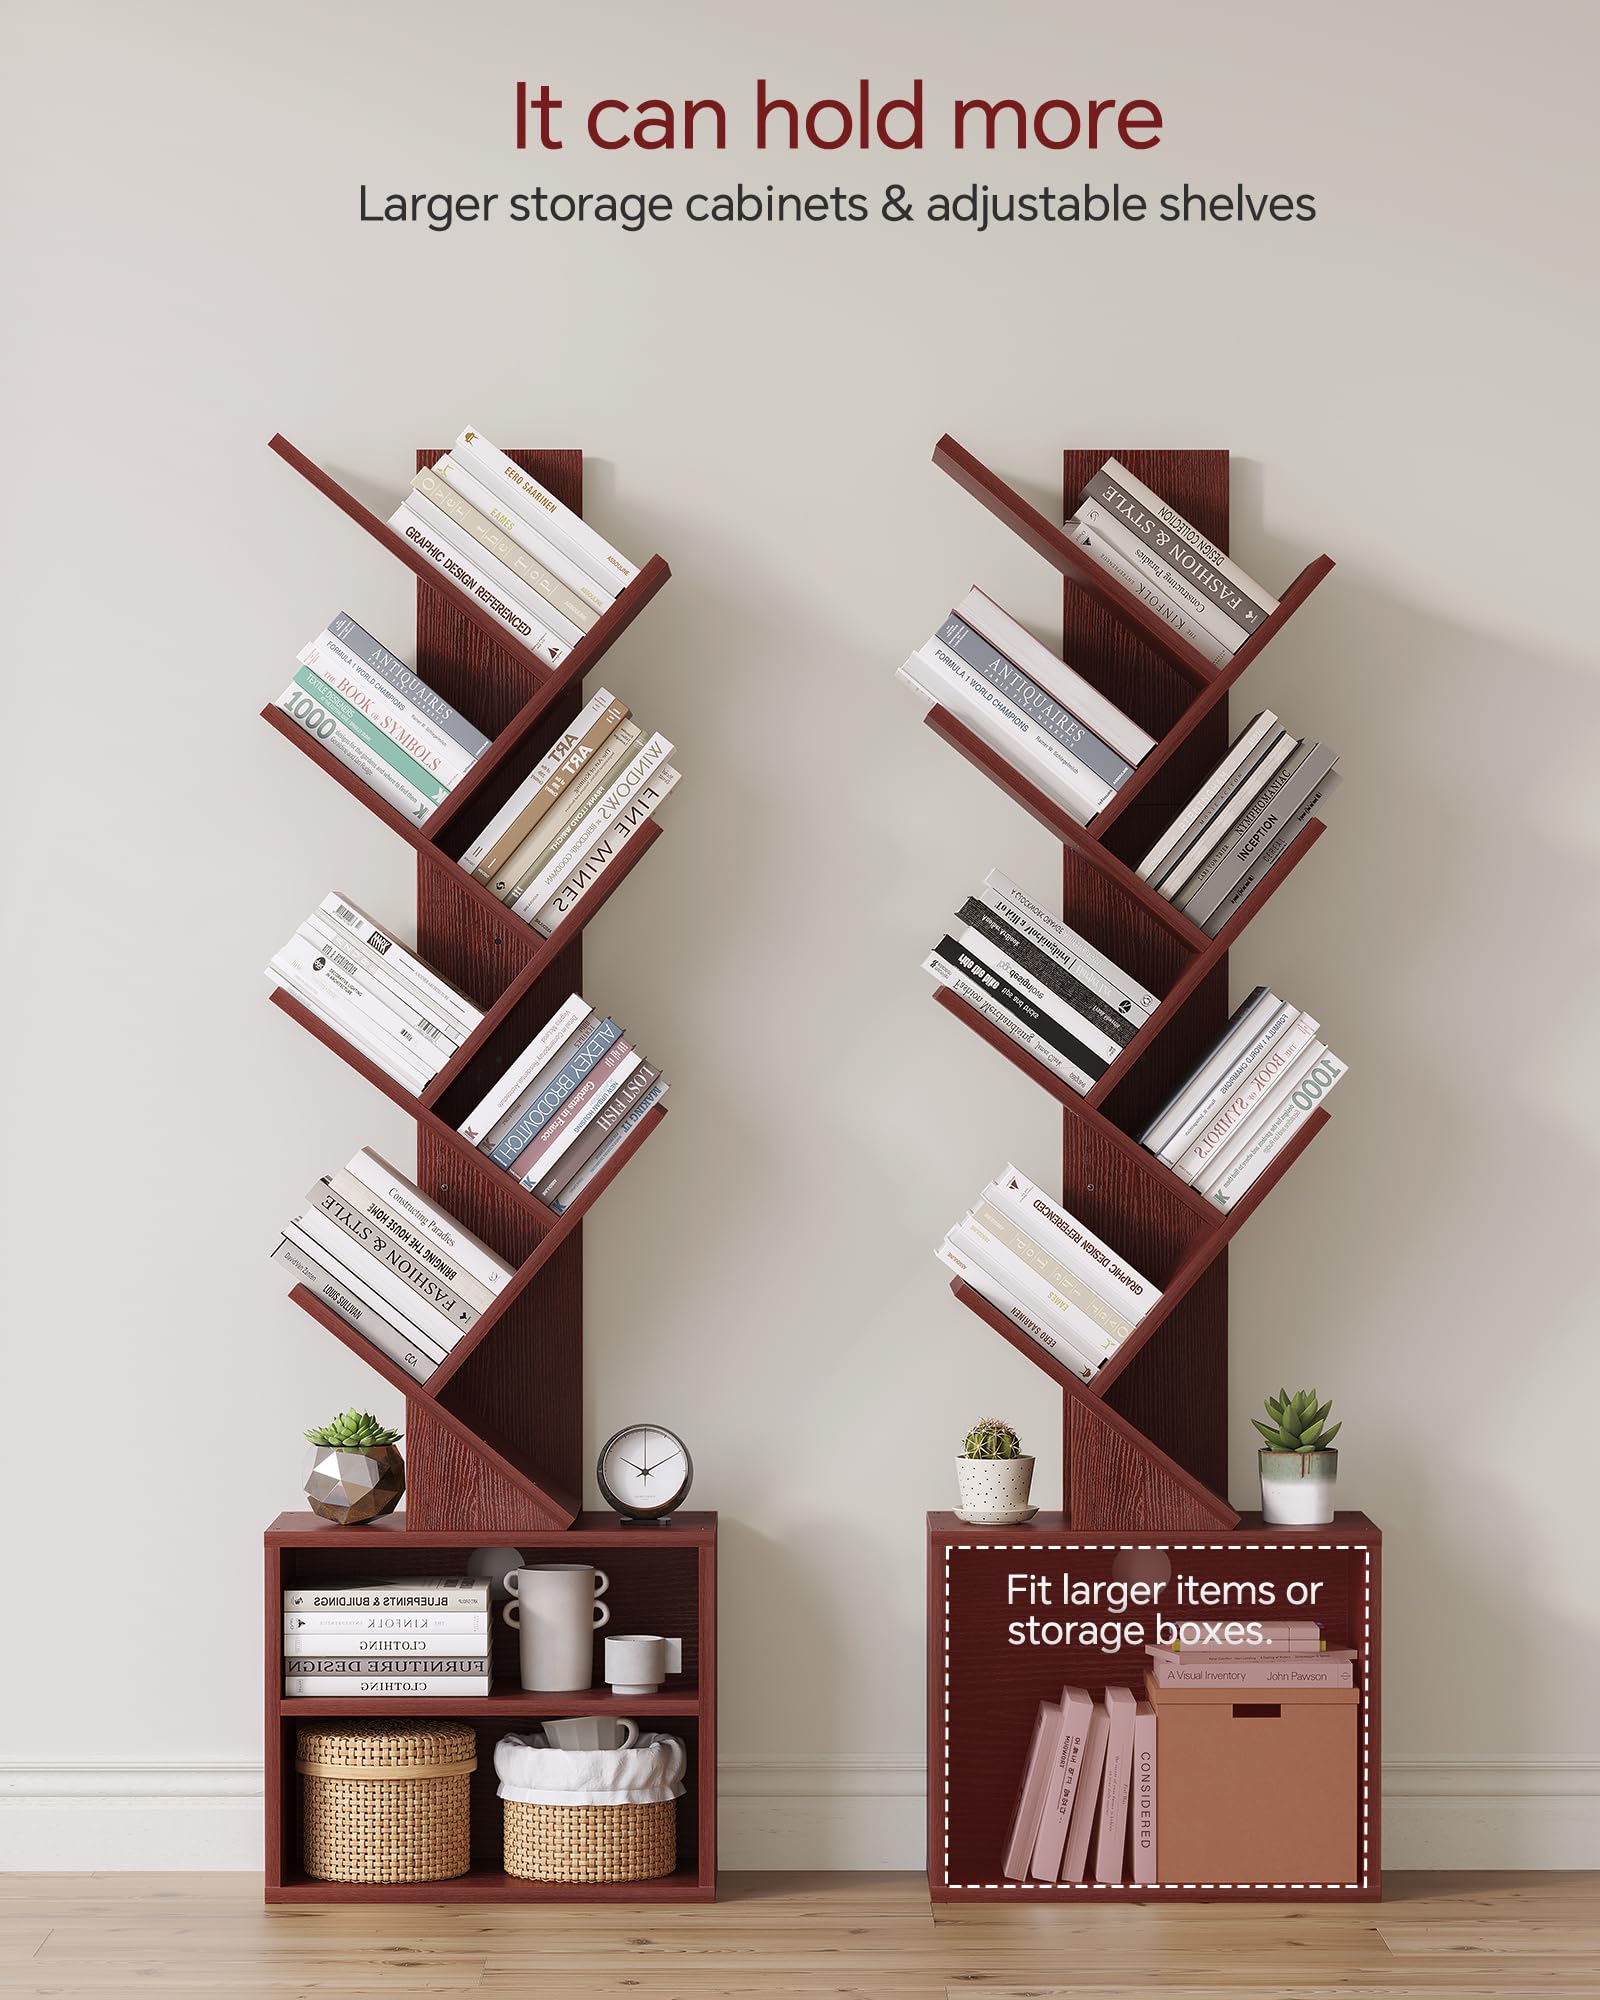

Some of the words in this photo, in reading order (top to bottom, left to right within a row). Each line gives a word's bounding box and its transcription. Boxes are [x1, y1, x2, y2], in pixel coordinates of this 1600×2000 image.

[503, 466, 523, 485] EERO
[521, 481, 557, 513] SAARINEN
[489, 508, 514, 531] EAMES
[1101, 485, 1155, 533] STYLE
[1157, 506, 1199, 544] COLLECTION
[1153, 528, 1171, 547] &
[1196, 539, 1224, 566] DESIGN
[405, 526, 445, 562] GRAPHIC
[442, 558, 477, 590] DESIGN
[474, 585, 531, 636] REFERENCED
[1134, 548, 1164, 577] Paradies
[1168, 543, 1242, 609] FASHION
[1135, 582, 1185, 629] KINFOLK
[1162, 571, 1205, 612] Constructing
[326, 640, 352, 665] FORMULA
[355, 665, 376, 685] WORLD
[373, 682, 405, 711] CHAMPIONS
[371, 648, 452, 719] ANTIQUAIRES
[934, 649, 965, 678] FORMULA
[969, 678, 993, 701] WORLD
[991, 698, 1029, 732] CHAMPIONS
[306, 672, 328, 694] TEXTILE
[324, 690, 355, 718] DESIGNERS
[988, 658, 1085, 741] ANTIQUAIRES
[283, 691, 336, 739] 1000
[336, 677, 374, 713] BOOK
[379, 716, 441, 771] SYMBOLS
[1234, 769, 1290, 835] NYMPHOMANIAC
[1236, 813, 1278, 861] INCEPTION
[569, 1023, 614, 1079] ALEXEY
[567, 1080, 594, 1109] Gardens
[591, 1092, 609, 1111] URBAN
[606, 1080, 619, 1094] NEW
[621, 1065, 654, 1103] LOST
[498, 1073, 575, 1159] BRODOVITCH
[560, 1107, 572, 1117] in
[596, 1098, 627, 1131] FISH
[628, 1085, 661, 1123] MAKING
[540, 1116, 565, 1141] France
[620, 1119, 632, 1133] IT
[321, 1194, 372, 1240] STYLE
[366, 1202, 390, 1224] HOME
[385, 1218, 412, 1243] HOUSE
[388, 1187, 429, 1226] Constructing
[427, 1219, 455, 1246] Paradies
[1032, 1198, 1083, 1243] REFERENCED
[370, 1235, 388, 1253] &
[407, 1237, 424, 1254] THE
[1079, 1239, 1110, 1267] DESIGN
[385, 1249, 456, 1311] FASHION
[421, 1249, 457, 1281] BRINGING
[1108, 1263, 1143, 1295] GRAPHIC
[322, 1283, 340, 1301] LOUIS
[336, 1295, 362, 1320] SULLIVAN
[1047, 1290, 1069, 1311] EAMES
[1010, 1306, 1041, 1334] SAARINEN
[1039, 1331, 1057, 1348] EERO
[1168, 1671, 1175, 1679] A
[1176, 1671, 1202, 1680] Visual
[1206, 1671, 1246, 1681] Inventory
[1267, 1672, 1289, 1680] John
[1292, 1672, 1327, 1681] Pawson
[1141, 1752, 1150, 1848] CONSIDERED
